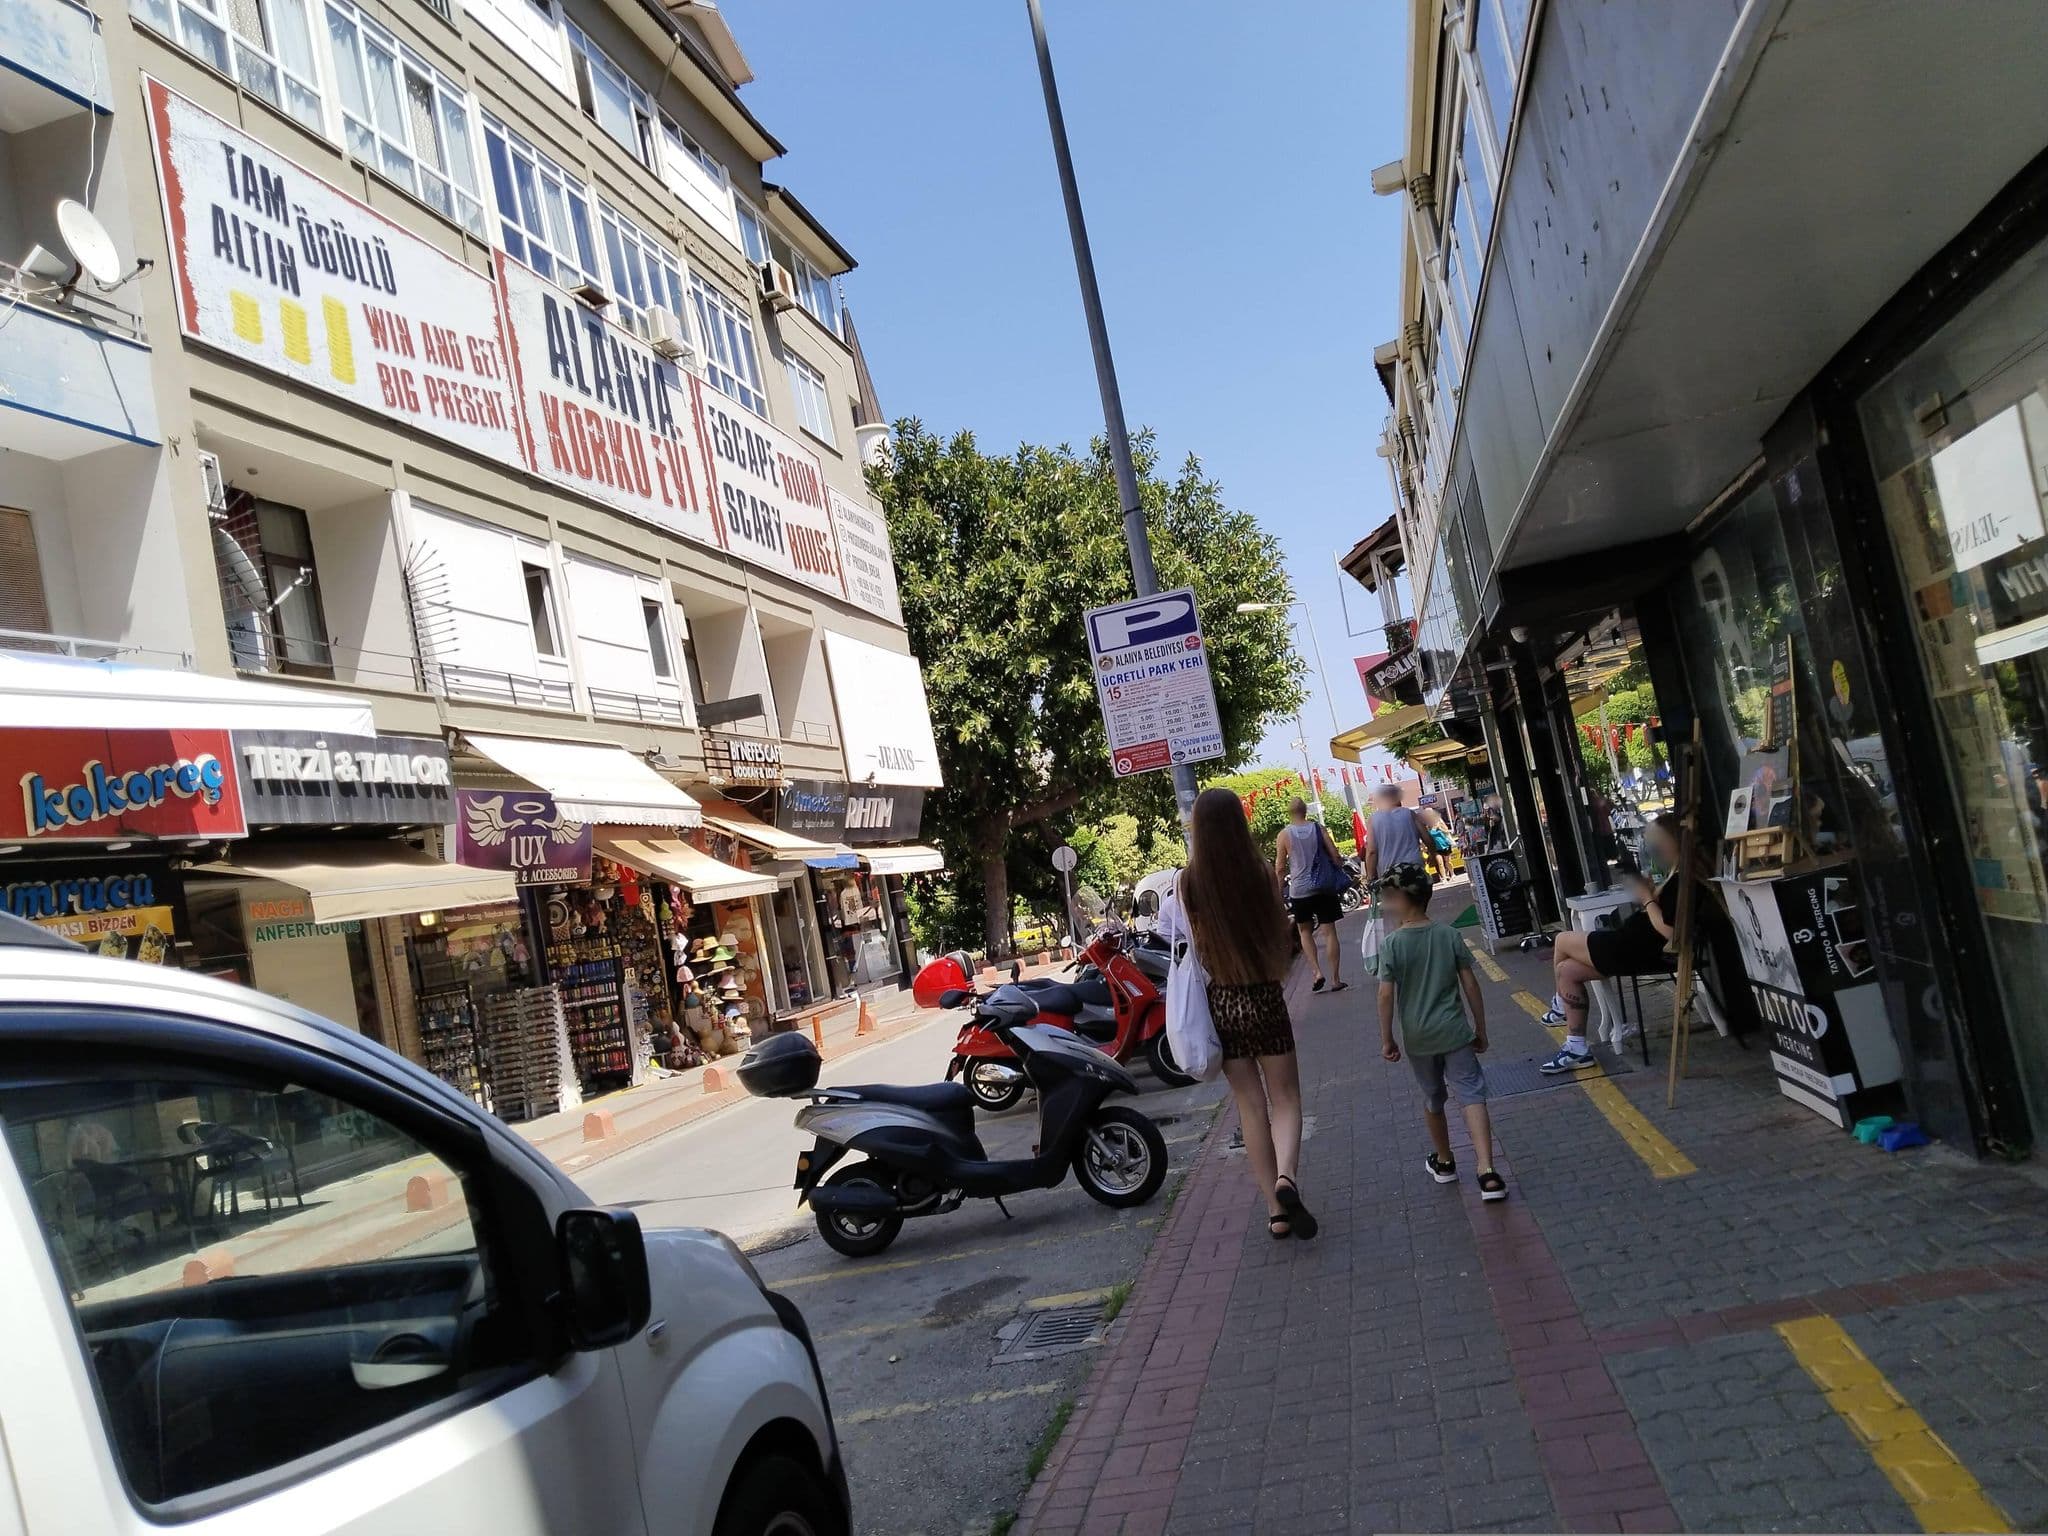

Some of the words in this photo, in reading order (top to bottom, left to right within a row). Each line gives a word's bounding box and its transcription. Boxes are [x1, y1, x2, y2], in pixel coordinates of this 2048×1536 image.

[220, 141, 290, 228] TAM
[211, 203, 301, 298] ALTIN
[298, 203, 399, 297] ÖDÜLLÜ
[361, 302, 417, 361] WIN
[421, 321, 465, 373] AND
[467, 335, 502, 382] GET
[542, 292, 677, 441] ALANYA
[376, 361, 422, 414] BIG
[424, 373, 509, 431] PRESENT
[539, 390, 654, 500] KORKU
[707, 404, 779, 489] ESCAPE
[777, 452, 824, 512] ROOM
[723, 481, 786, 556] SCARY
[785, 521, 837, 578] HOUSE
[1101, 669, 1147, 688] ÜCRETLİ
[1148, 660, 1176, 678] PARK
[1178, 655, 1204, 672] YERİ
[1115, 650, 1144, 668] ALANYA
[1144, 638, 1185, 662] BELEDİYESİ
[1106, 686, 1122, 701] 15
[243, 739, 332, 782] TERZİ
[333, 751, 360, 782] &
[355, 751, 452, 786] TAILOR
[878, 745, 916, 771] JEANS
[1188, 746, 1201, 756] 444
[1212, 742, 1222, 752] 07
[18, 754, 226, 836] kokoreç
[510, 835, 548, 868] LUX
[530, 867, 578, 882] ACCESSORIES
[0, 873, 156, 919] mrucu
[250, 901, 305, 919] NACH
[1807, 888, 1826, 929] PIERCING
[88, 914, 138, 934] BİZDEN
[1823, 940, 1840, 975] TATTOO
[1750, 984, 1828, 1040] TATTOO
